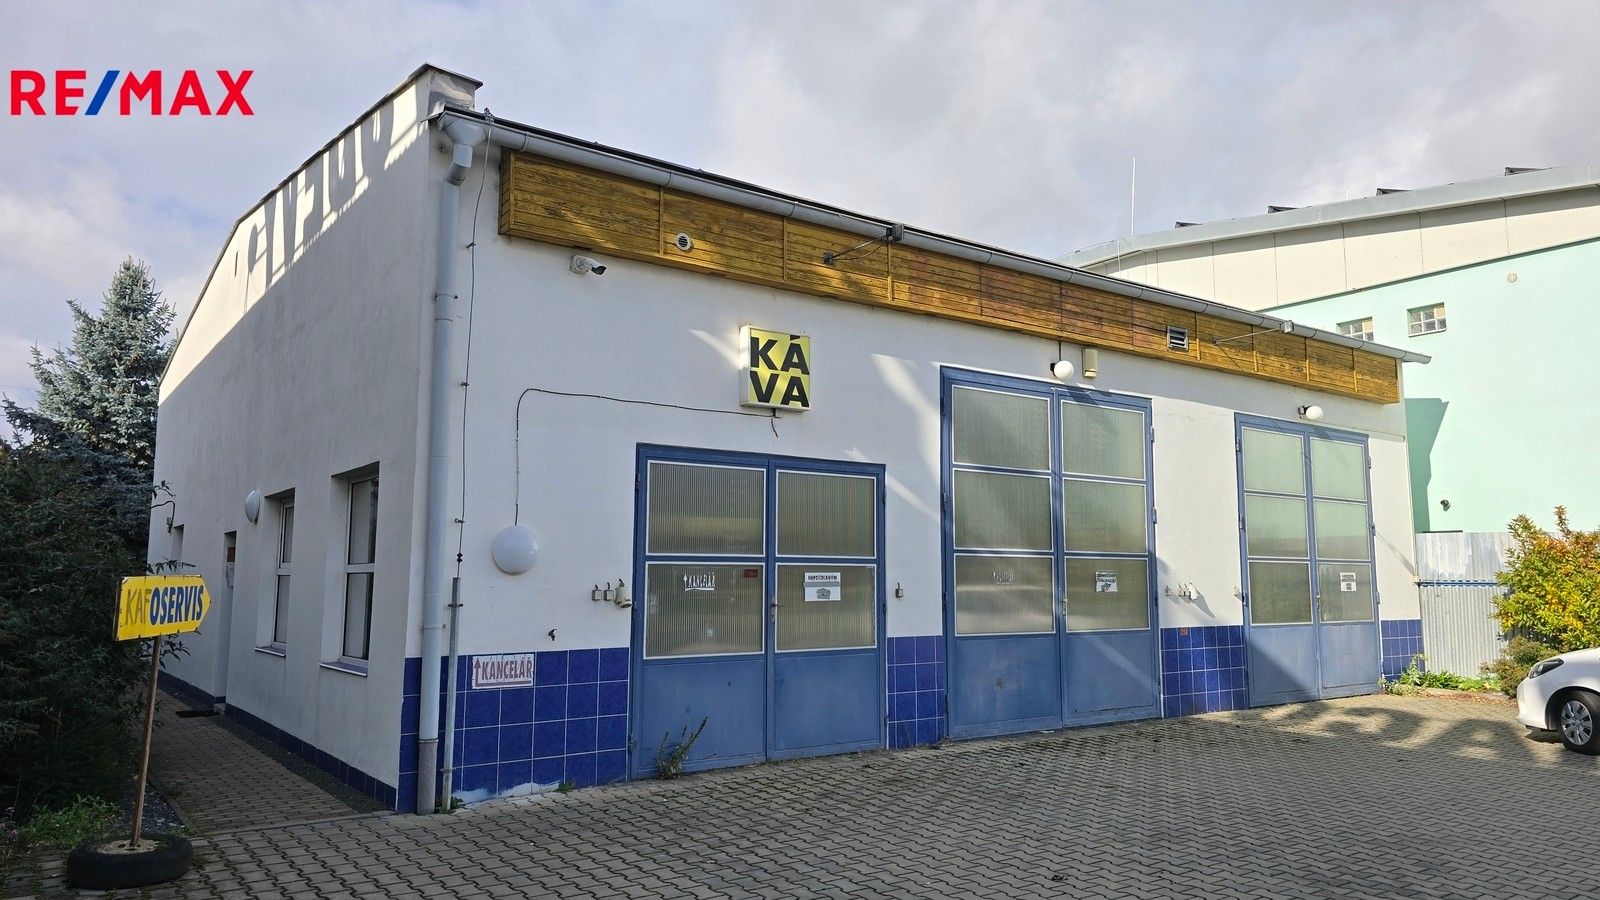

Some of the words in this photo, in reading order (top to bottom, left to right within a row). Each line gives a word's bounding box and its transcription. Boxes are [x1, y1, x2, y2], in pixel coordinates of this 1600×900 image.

[750, 335, 810, 375] KÁ
[750, 370, 810, 407] VA
[481, 657, 533, 681] KANCELÁŘ
